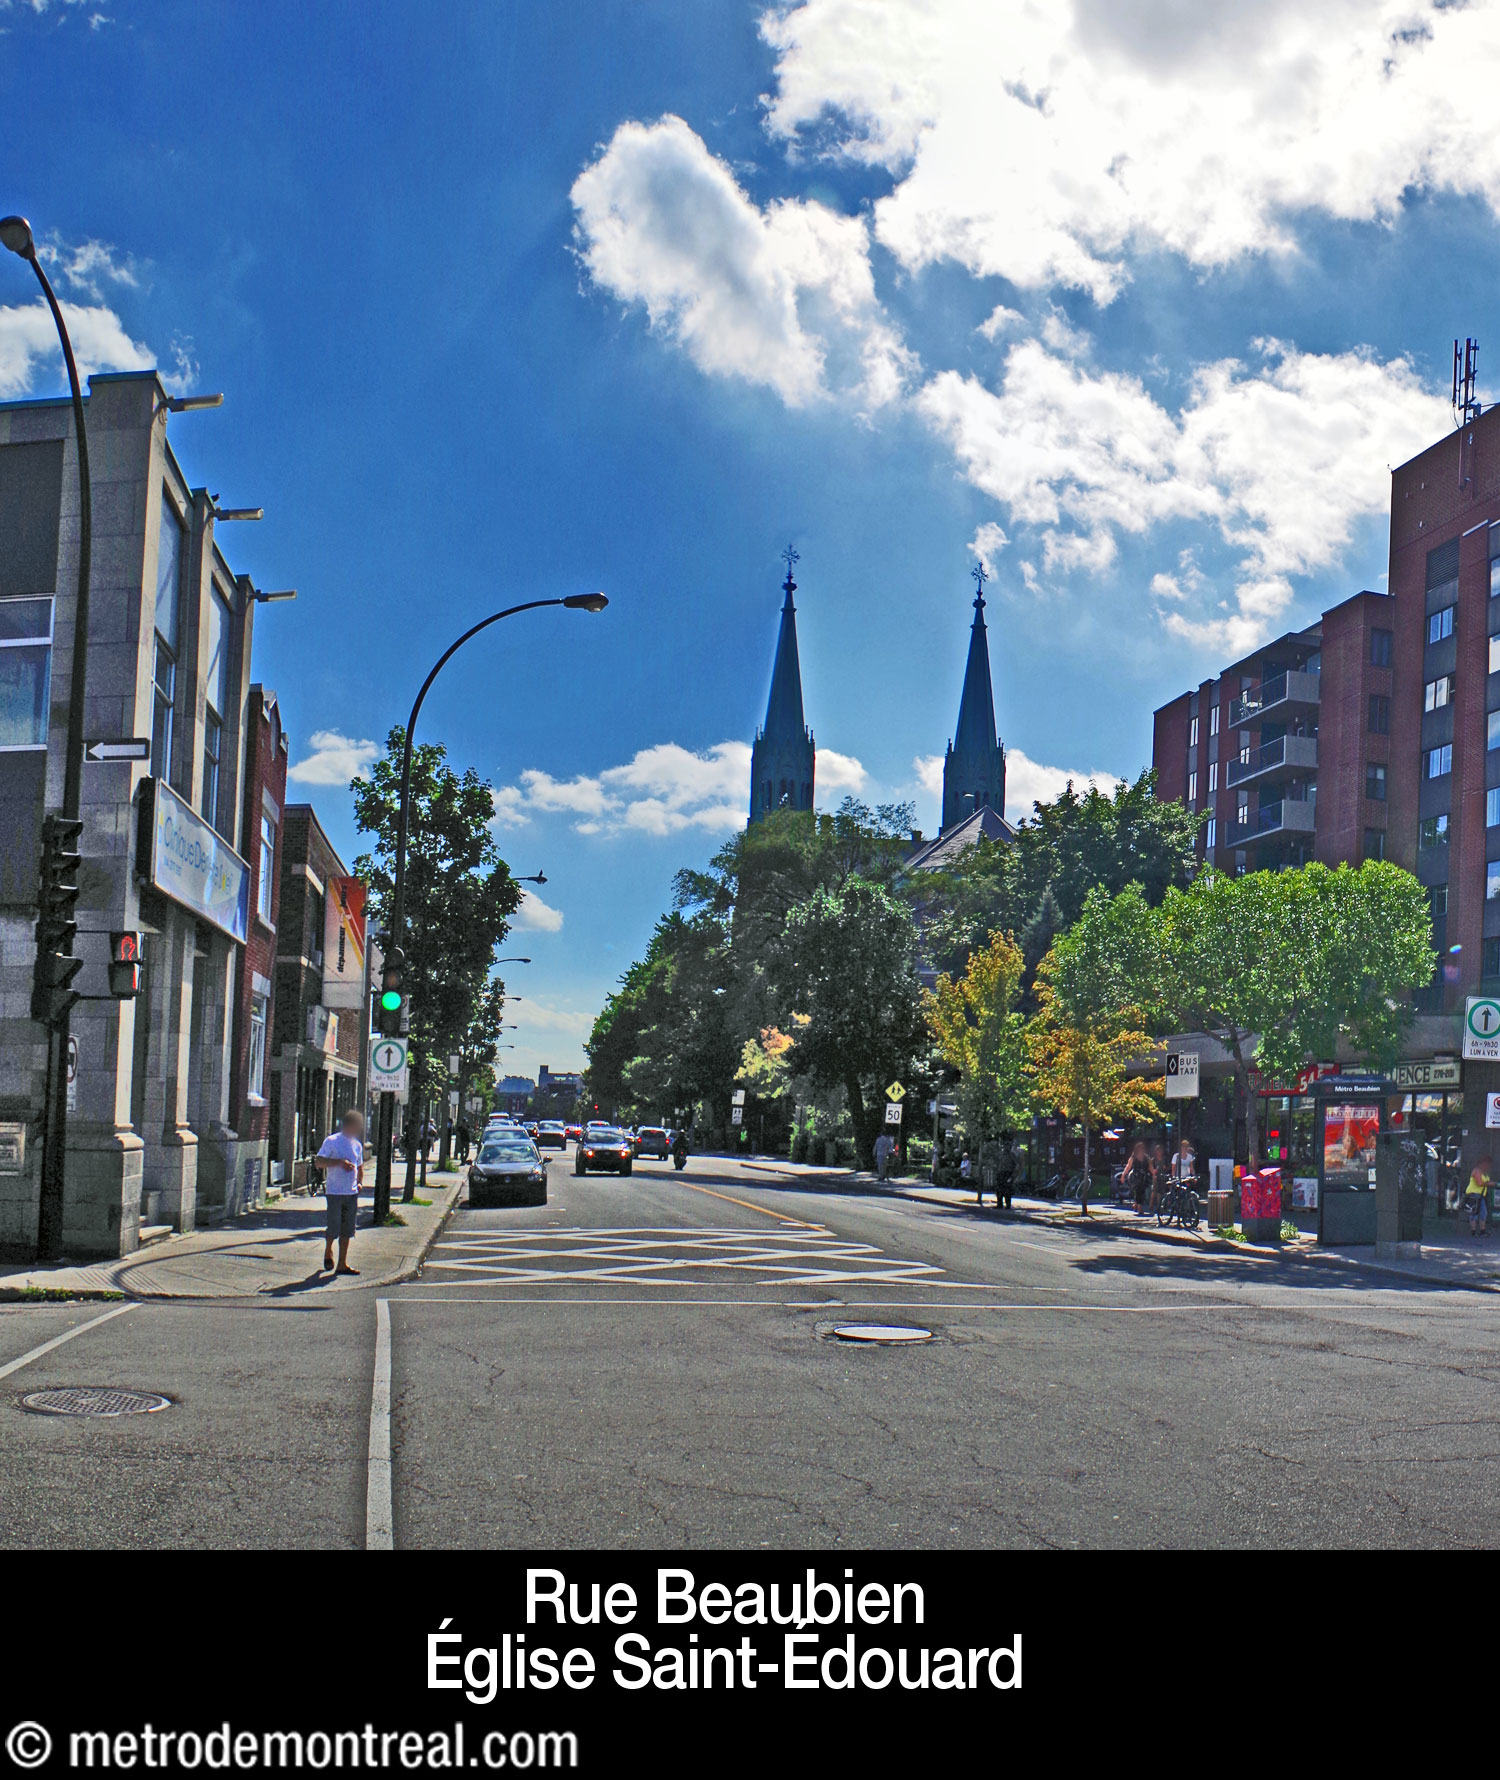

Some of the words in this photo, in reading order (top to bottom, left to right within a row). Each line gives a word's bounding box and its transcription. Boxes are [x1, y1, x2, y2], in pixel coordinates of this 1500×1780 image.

[1471, 1040, 1479, 1048] 6h
[1180, 1057, 1198, 1066] BUS
[1180, 1067, 1198, 1075] TAXI
[887, 1109, 900, 1121] 50
